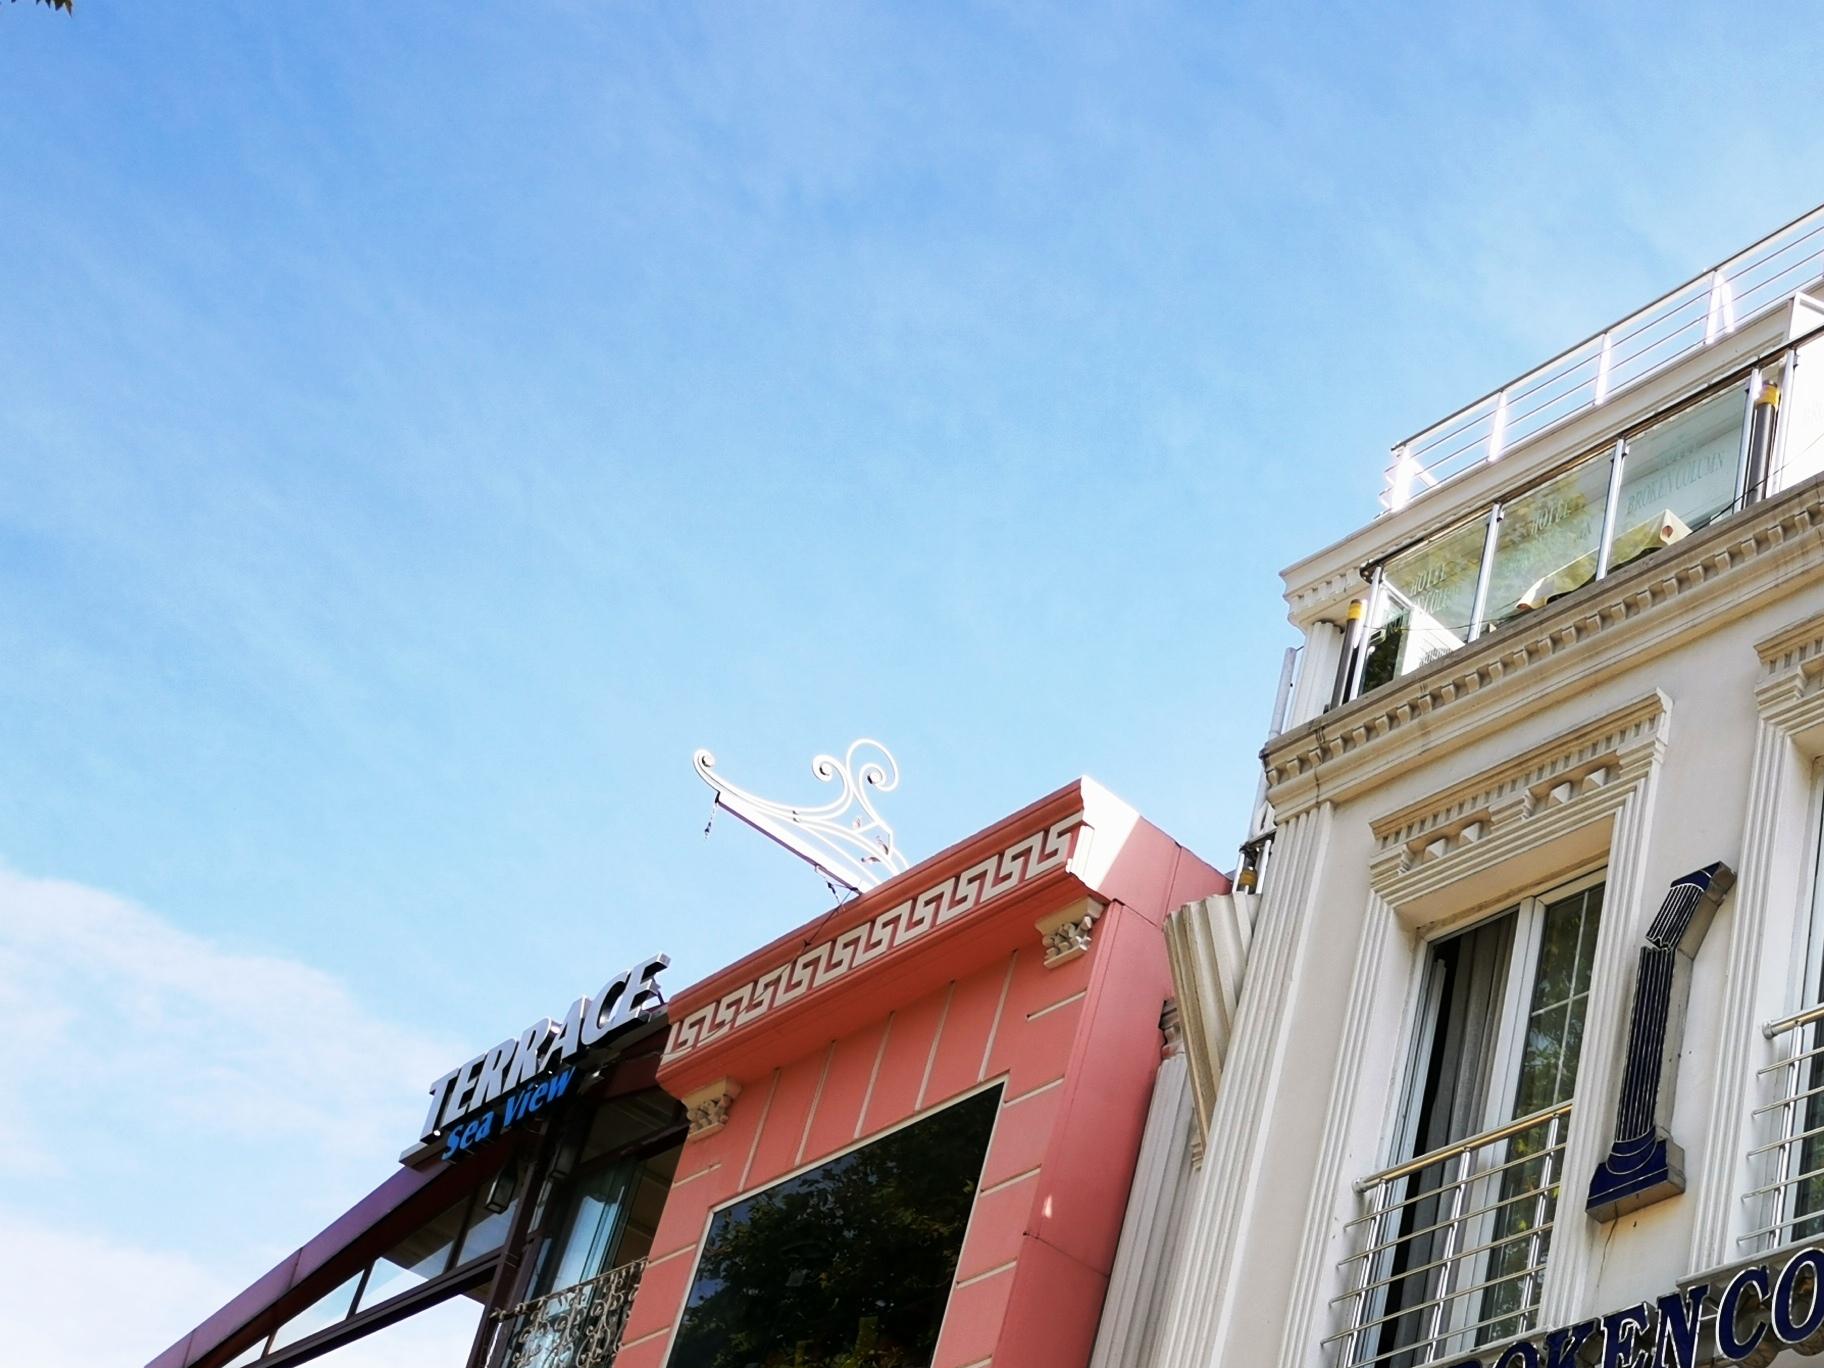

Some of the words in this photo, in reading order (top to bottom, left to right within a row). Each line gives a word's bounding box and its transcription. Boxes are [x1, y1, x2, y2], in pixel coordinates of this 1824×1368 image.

[420, 952, 671, 1143] TERRACE
[441, 1111, 494, 1161] Sea
[503, 1066, 577, 1129] View
